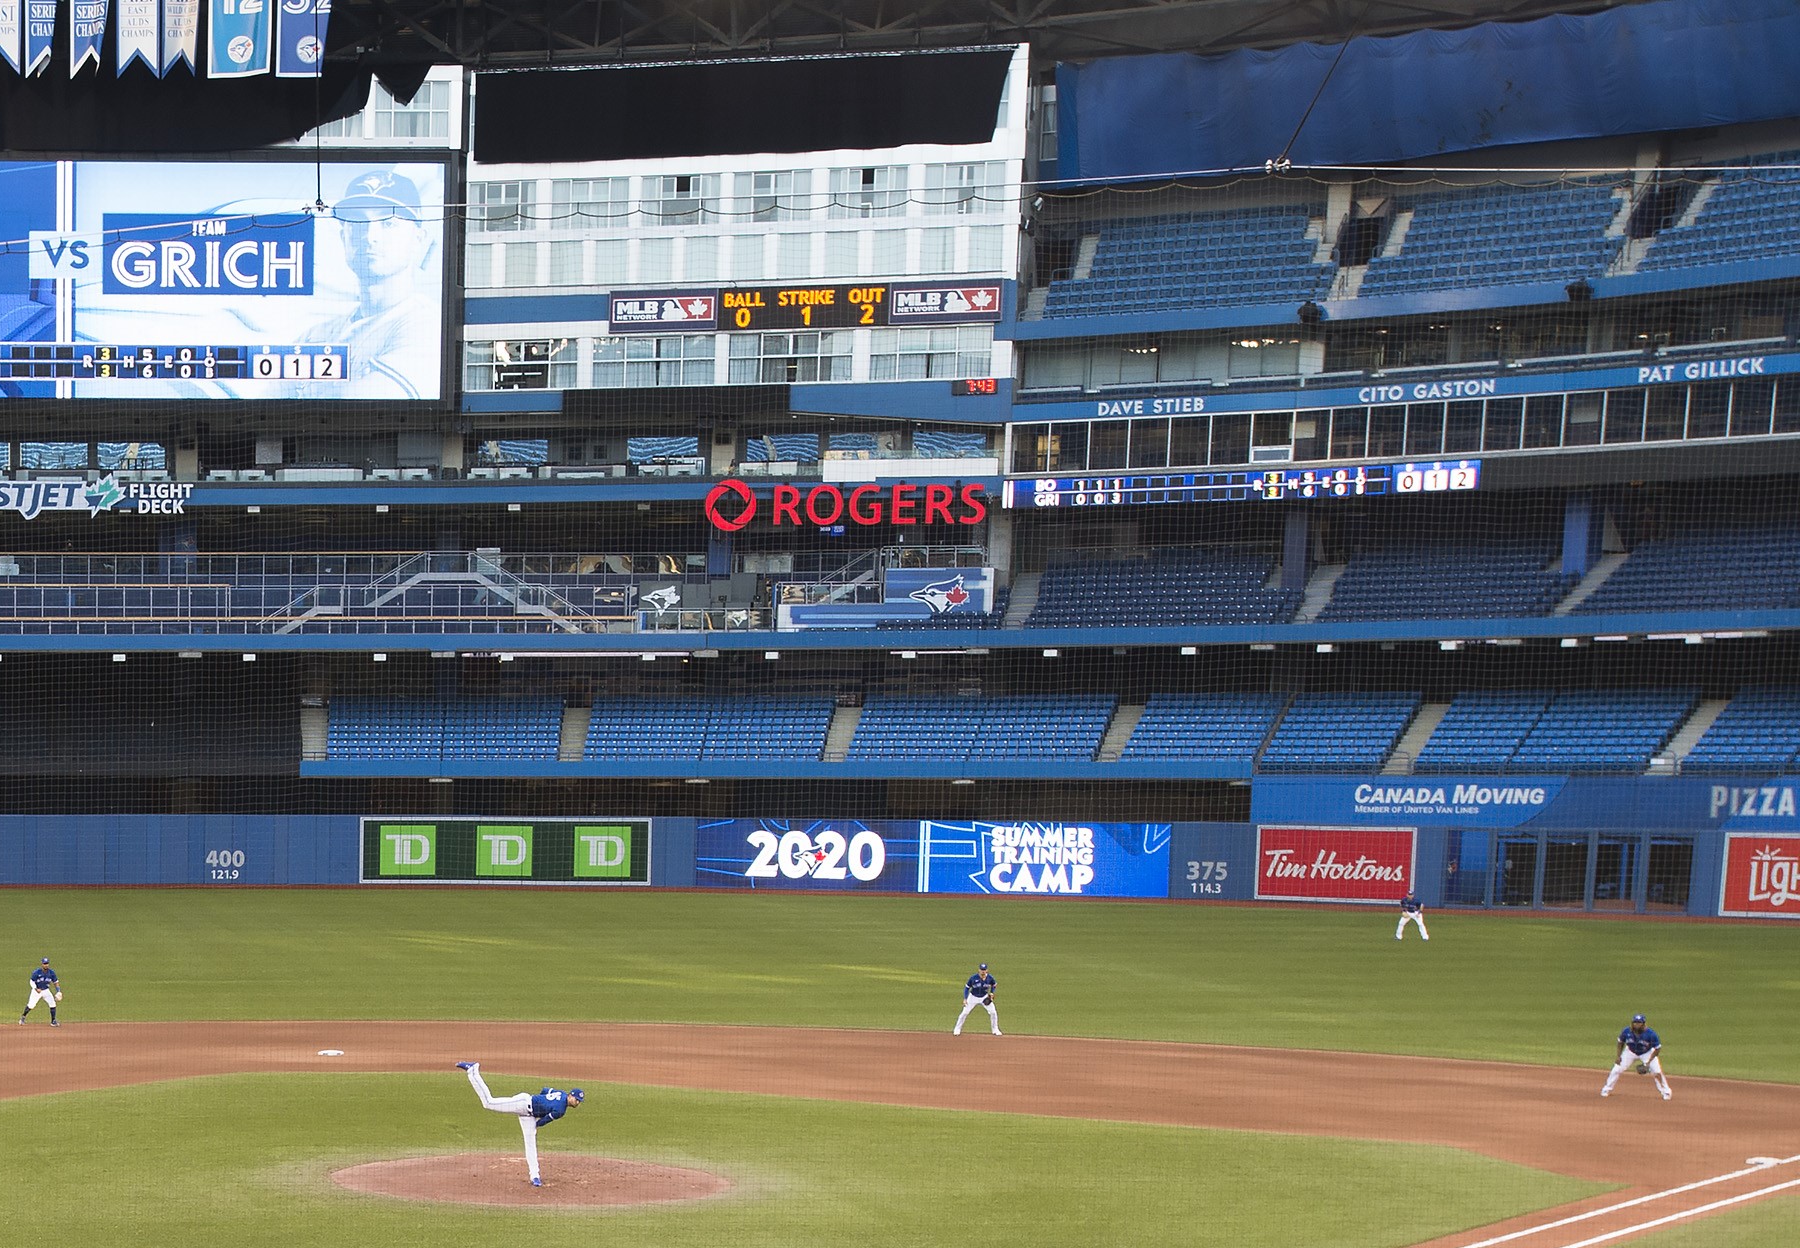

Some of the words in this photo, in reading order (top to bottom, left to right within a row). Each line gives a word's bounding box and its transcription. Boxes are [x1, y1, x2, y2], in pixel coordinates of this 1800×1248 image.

[76, 3, 105, 19] SERIES
[128, 6, 148, 14] EAST
[75, 20, 105, 37] CHAMPS
[128, 17, 149, 25] ALDS
[121, 30, 154, 38] CHAMPS
[192, 219, 226, 237] TEAM
[43, 239, 89, 269] VS
[111, 240, 305, 289] GRICH
[723, 291, 766, 308] BALL
[778, 289, 836, 306] STRIKE
[847, 288, 885, 305] OUT
[897, 290, 941, 308] MLB
[615, 299, 659, 316] MLB
[616, 312, 659, 321] NETWORK
[735, 308, 751, 328] 0
[801, 306, 811, 326] 1
[860, 304, 875, 325] 2
[897, 303, 941, 313] NETWORK
[83, 355, 93, 368] R
[123, 355, 134, 368] H
[164, 355, 172, 368] E
[101, 347, 111, 360] 3
[143, 348, 153, 362] 5
[180, 348, 191, 362] 0
[101, 364, 111, 377] 3
[143, 364, 153, 378] 6
[180, 365, 191, 378] 0
[259, 358, 273, 376] 0
[293, 358, 300, 376] 1
[321, 358, 333, 376] 2
[1638, 366, 1674, 384] PAT
[1684, 358, 1764, 380] GILLICK
[1359, 384, 1403, 402] CITO
[1414, 379, 1496, 400] GASTON
[1098, 400, 1143, 417] DAVE
[1153, 398, 1205, 414] STIEB
[1035, 479, 1056, 492] BO
[1078, 480, 1084, 491] 1
[1096, 479, 1103, 491] 1
[1114, 479, 1120, 490] 1
[1403, 476, 1414, 489] 0
[1432, 474, 1439, 488] 1
[1457, 472, 1466, 487] 2
[129, 483, 194, 499] FLIGHT
[1034, 493, 1060, 507] GRI
[1075, 494, 1086, 505] 0
[1094, 493, 1104, 504] 0
[1112, 492, 1121, 504] 3
[138, 499, 185, 515] DECK
[773, 483, 986, 526] ROGERS
[1354, 784, 1445, 804] CANADA
[1452, 784, 1545, 805] MOVING
[1709, 785, 1796, 819] PIZZA
[990, 826, 1095, 848] SUMMER
[206, 849, 245, 868] 400
[386, 834, 431, 865] TD
[483, 834, 528, 865] TD
[580, 835, 625, 866] TD
[745, 829, 886, 882] 2020
[990, 846, 1094, 865] TRAINING
[1186, 861, 1228, 882] 375
[1265, 848, 1307, 880] Tim
[1312, 848, 1404, 882] Hortons
[211, 869, 239, 880] 121.9
[990, 863, 1094, 893] CAMP
[1191, 882, 1222, 894] 114.3
